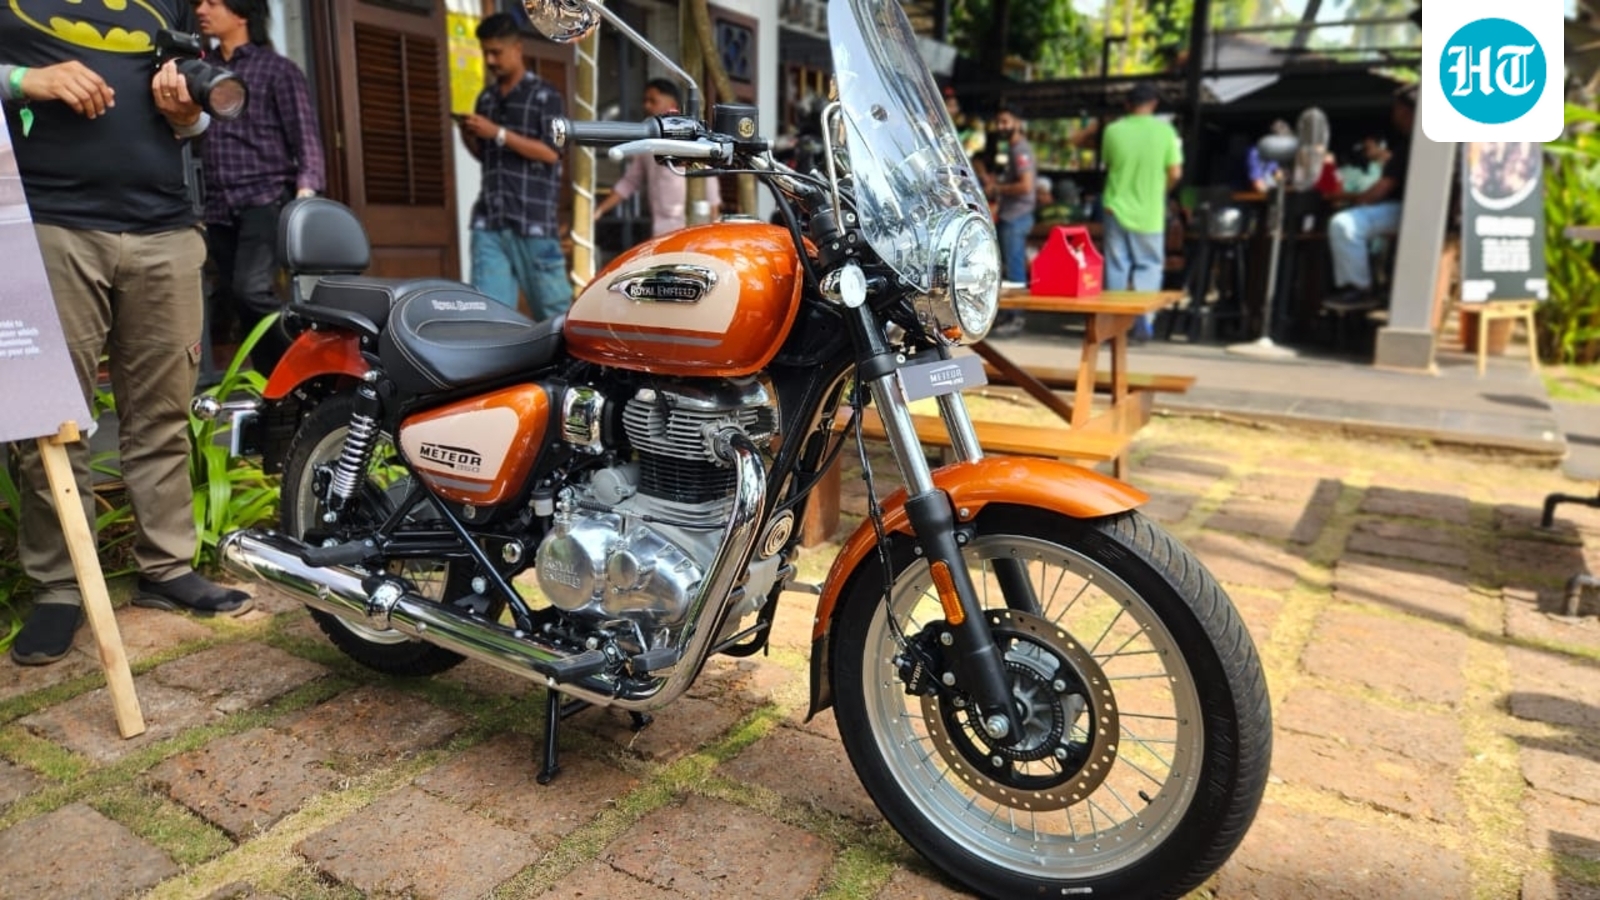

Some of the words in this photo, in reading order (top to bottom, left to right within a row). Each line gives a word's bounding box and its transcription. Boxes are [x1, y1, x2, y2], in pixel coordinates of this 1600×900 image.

[630, 284, 655, 296] ROYAL
[658, 284, 698, 299] ENFIELD
[930, 369, 962, 382] METEOR
[420, 446, 482, 466] METEOR
